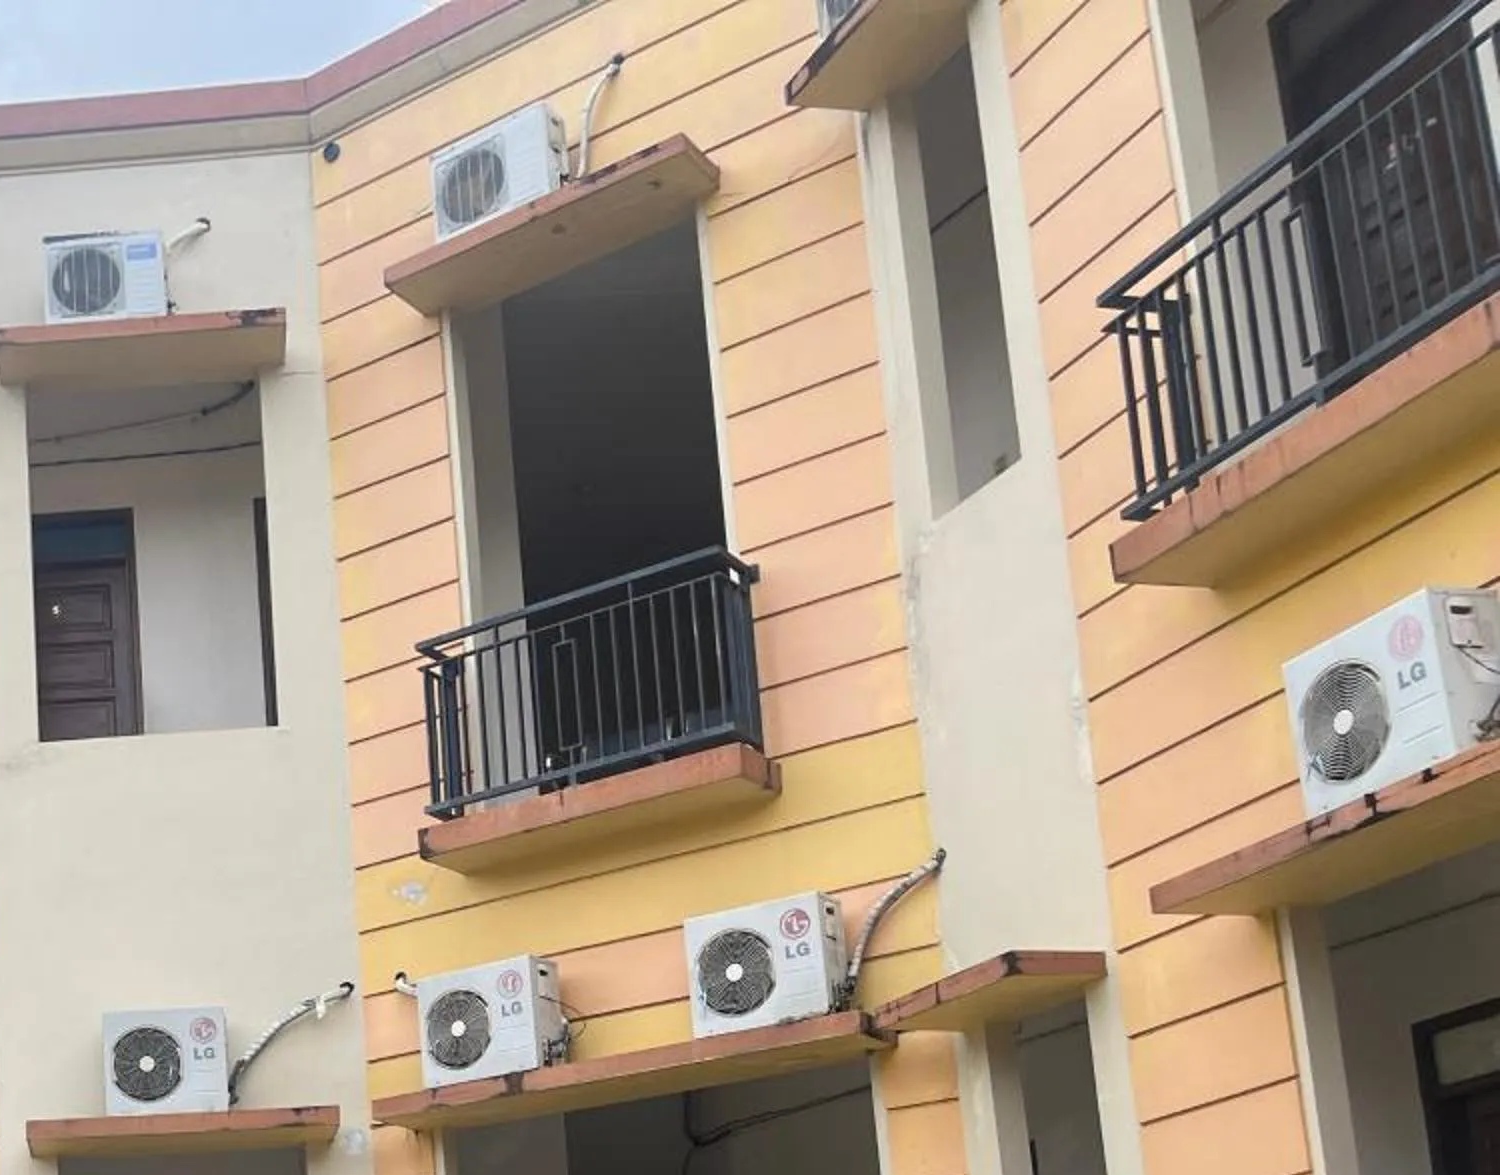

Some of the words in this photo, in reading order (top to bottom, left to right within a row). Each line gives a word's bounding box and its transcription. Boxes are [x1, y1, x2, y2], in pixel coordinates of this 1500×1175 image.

[1397, 661, 1428, 690] LG
[785, 941, 811, 960] LG
[501, 1001, 522, 1017] LG
[193, 1047, 215, 1061] LG
